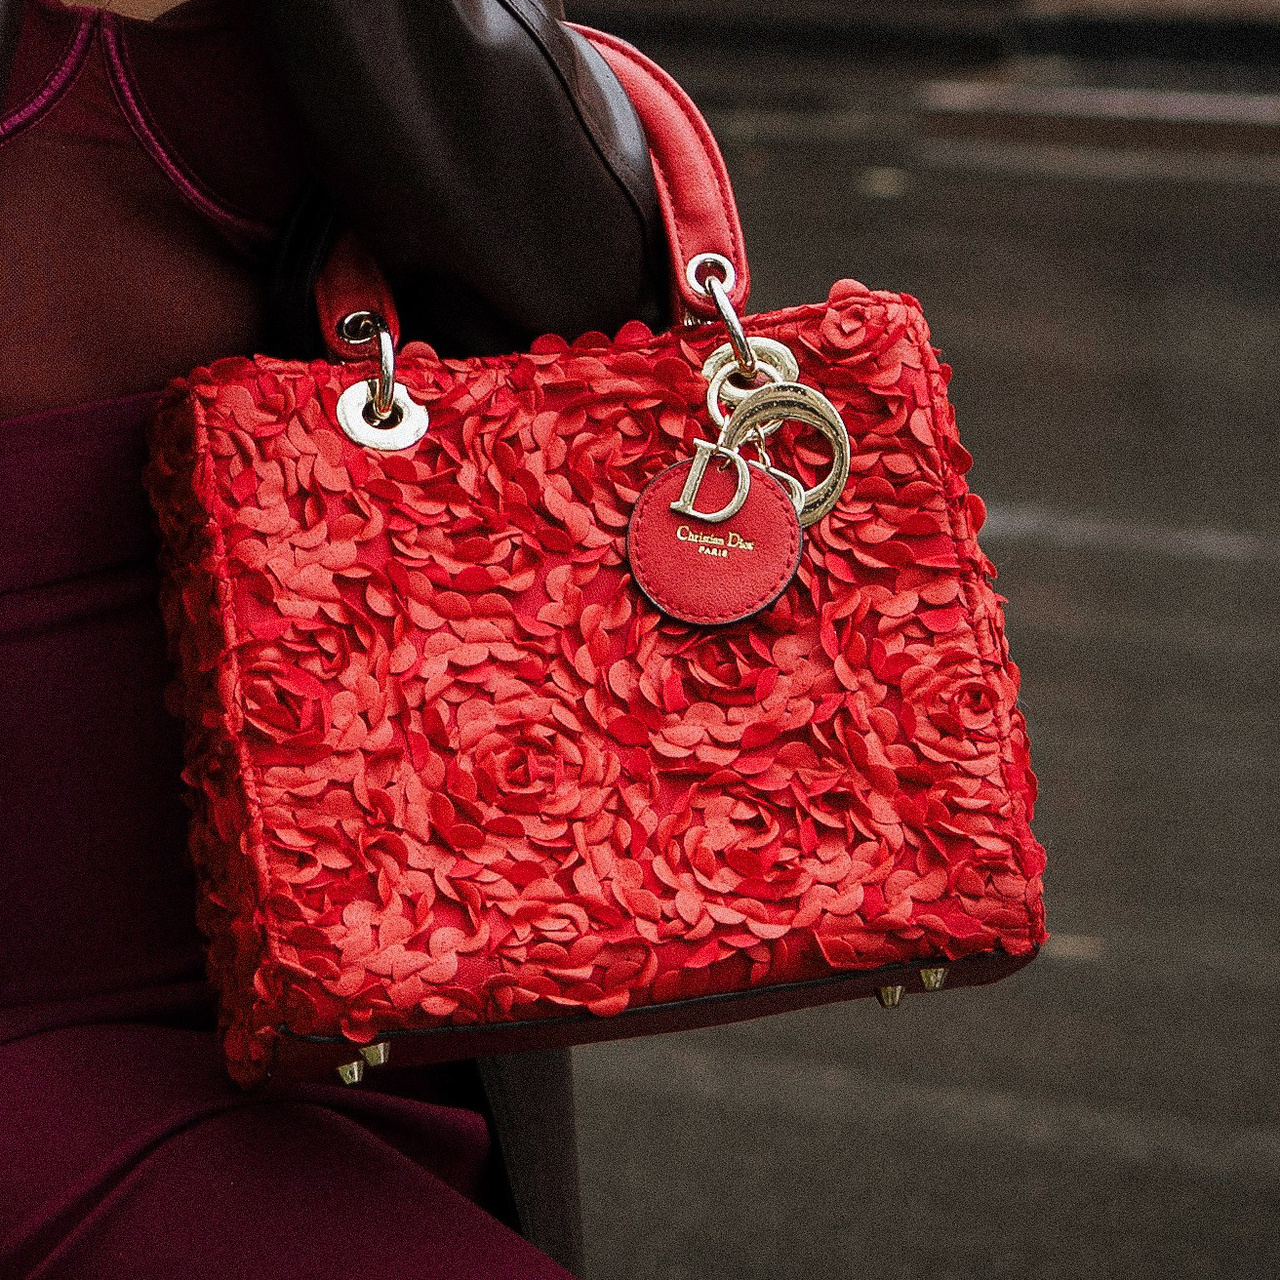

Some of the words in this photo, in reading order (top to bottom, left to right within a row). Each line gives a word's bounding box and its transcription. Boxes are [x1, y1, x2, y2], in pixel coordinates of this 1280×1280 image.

[676, 525, 725, 546] Christian
[727, 531, 755, 551] Dior
[697, 545, 729, 558] PARIS
